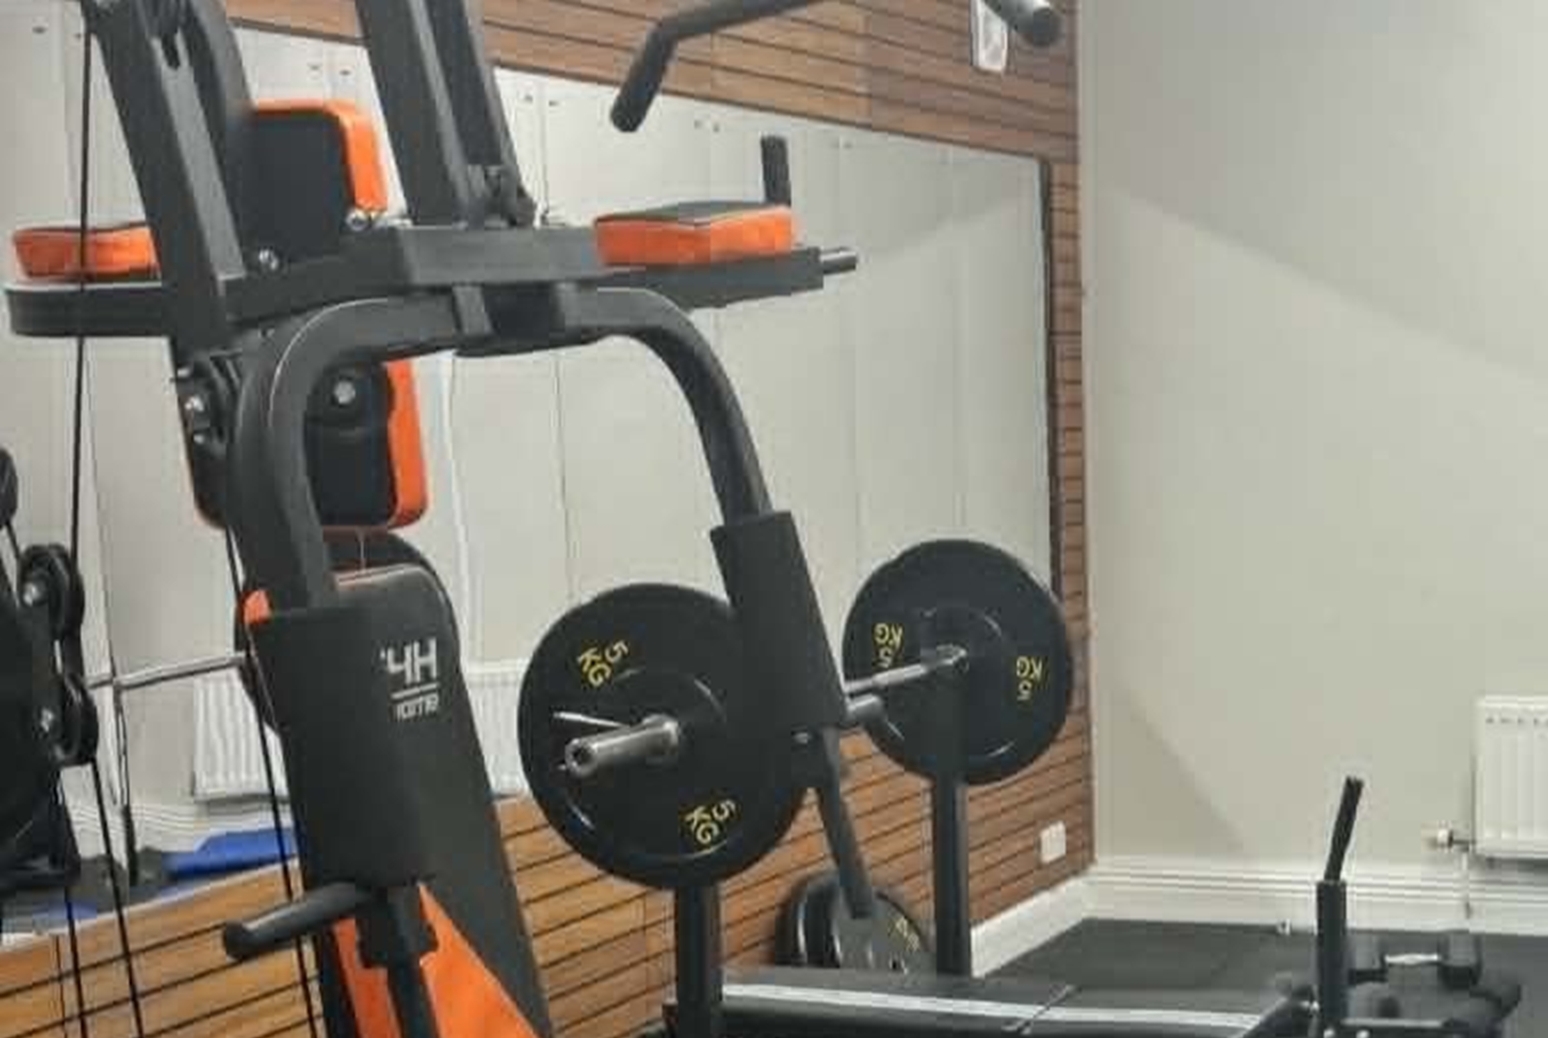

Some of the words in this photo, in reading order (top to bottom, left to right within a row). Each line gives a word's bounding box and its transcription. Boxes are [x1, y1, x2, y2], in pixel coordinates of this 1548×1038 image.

[875, 623, 902, 647] KG
[605, 640, 629, 663] 5
[577, 648, 611, 687] KG
[1016, 656, 1042, 682] KG
[1018, 681, 1031, 700] 5
[712, 800, 736, 822] 5
[686, 806, 718, 844] KG
